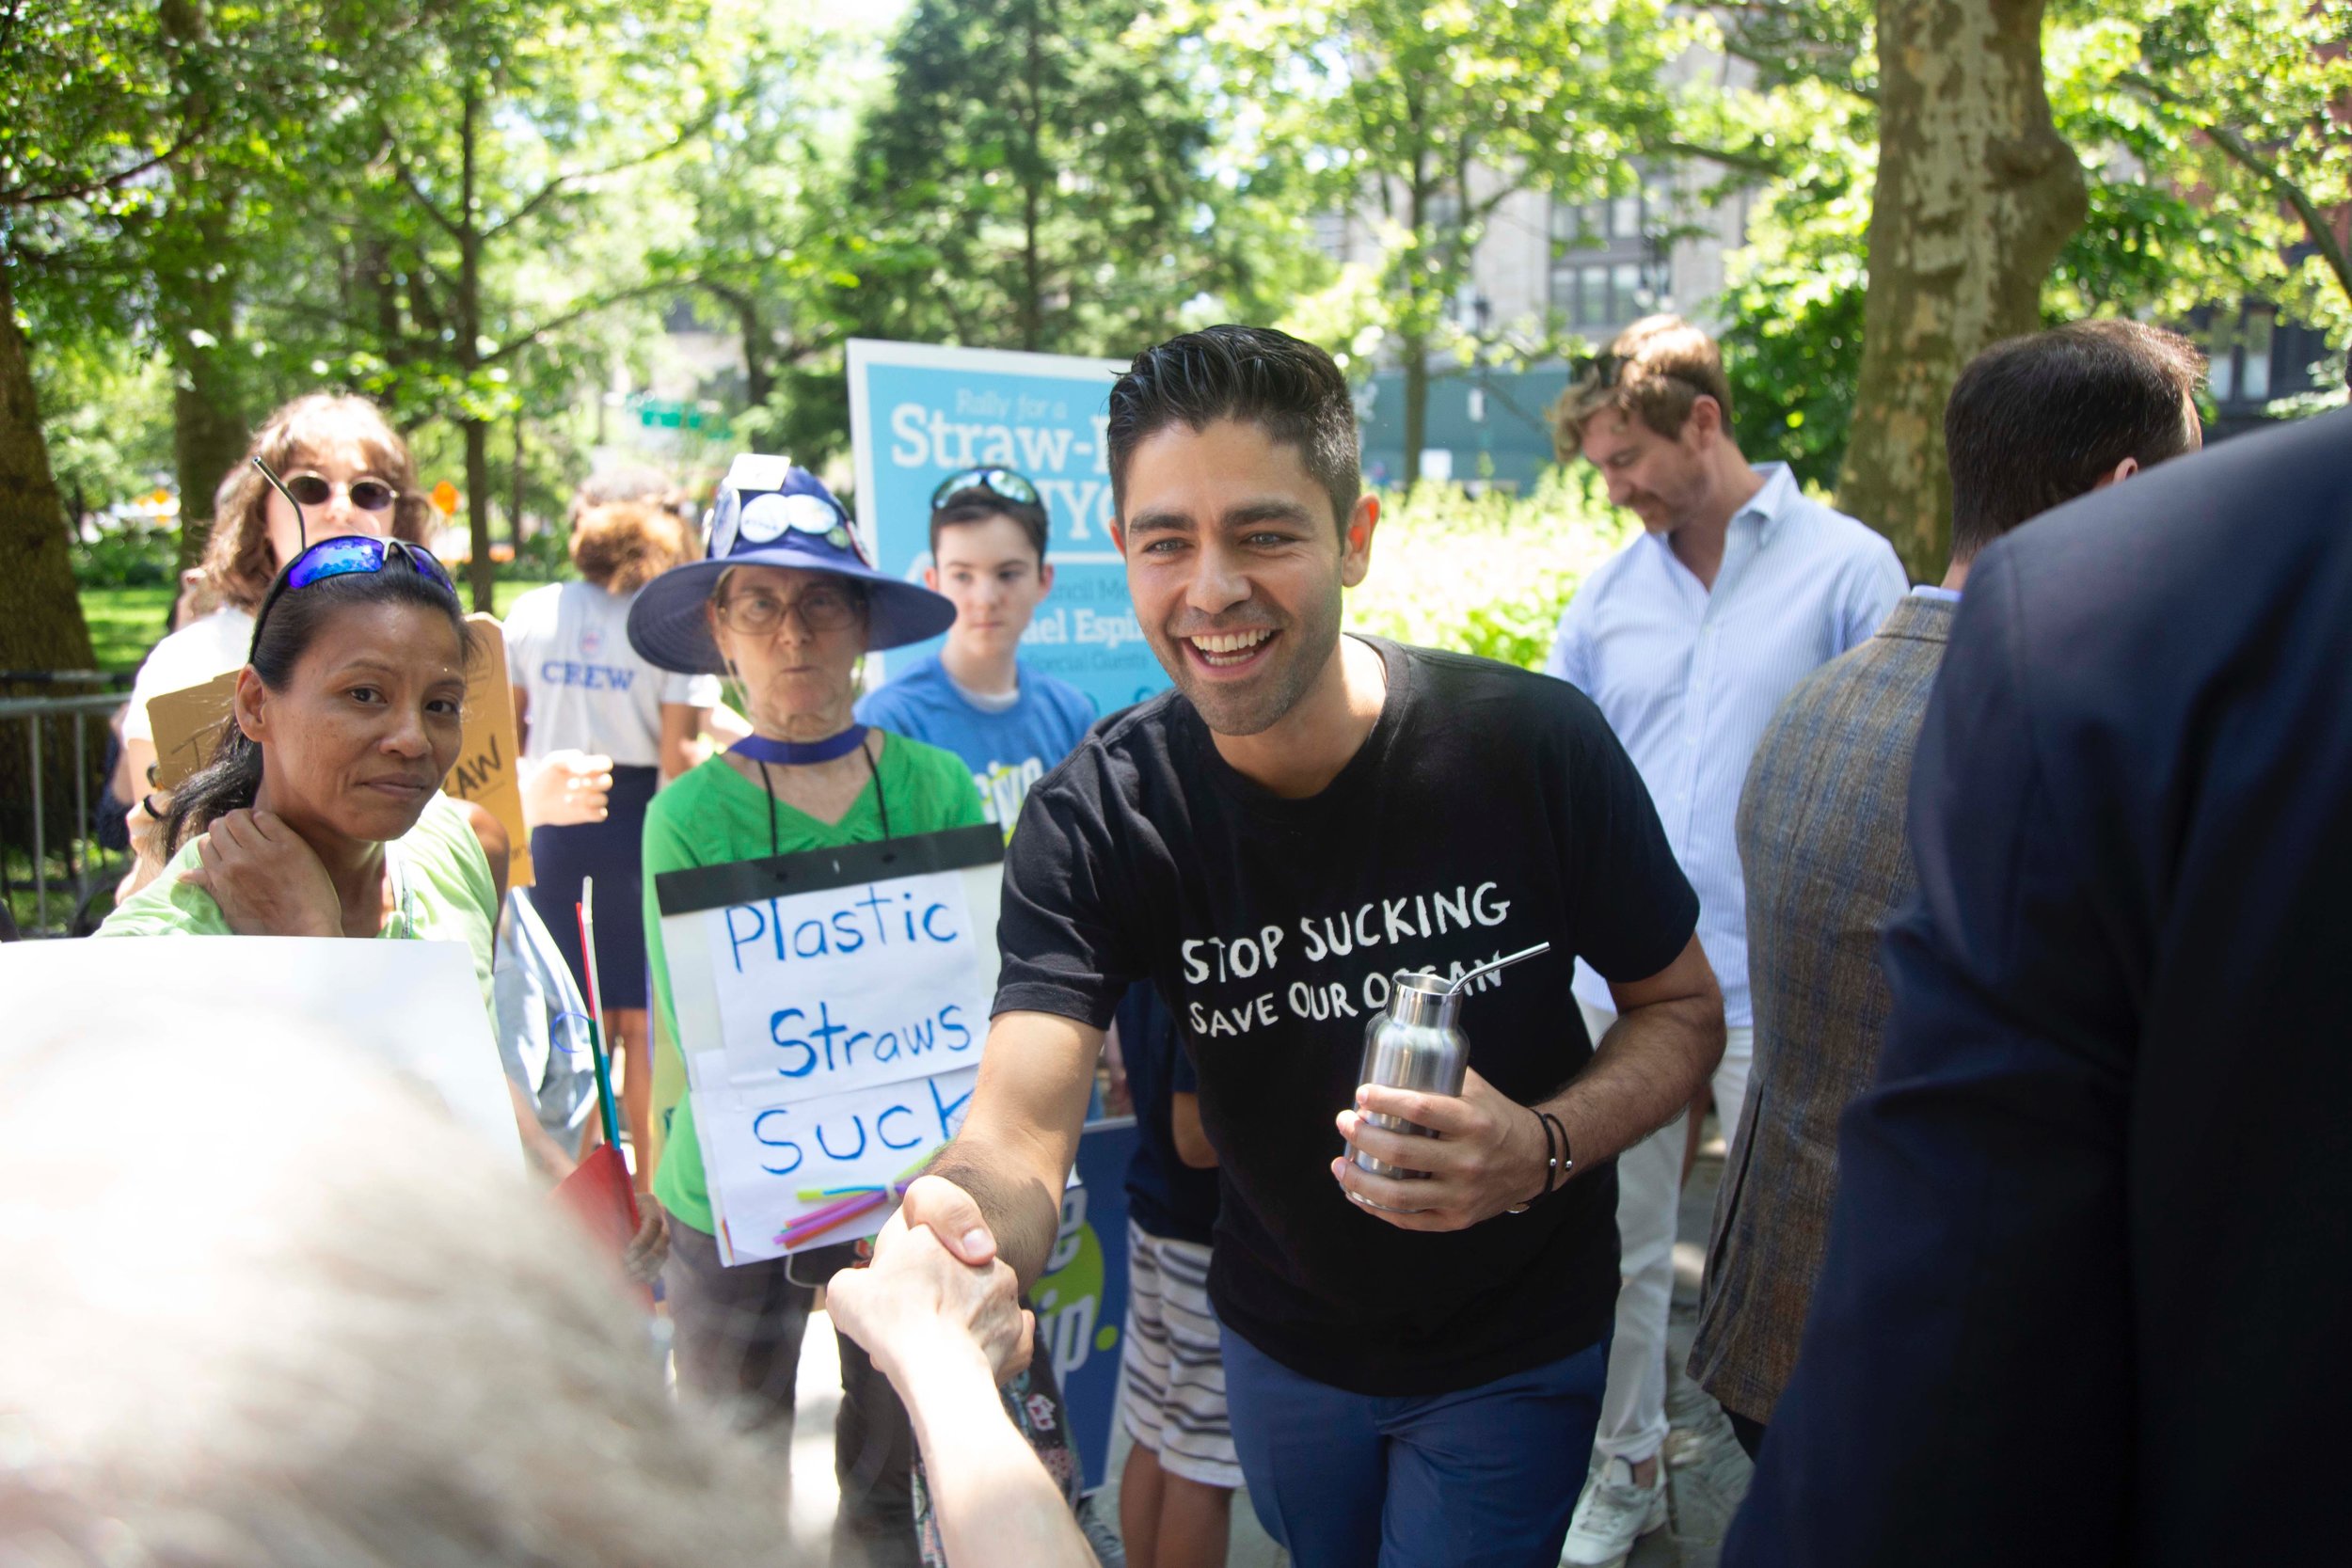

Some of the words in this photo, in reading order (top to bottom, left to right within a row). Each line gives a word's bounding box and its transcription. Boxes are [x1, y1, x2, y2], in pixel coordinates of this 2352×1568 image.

[541, 661, 636, 691] CREW
[445, 733, 503, 800] AW
[724, 885, 959, 974] Plastic
[1181, 925, 1284, 985] STOP
[1299, 880, 1511, 963] SUCKING
[1188, 991, 1279, 1037] SAVE
[1287, 980, 1359, 1022] OUR
[1362, 950, 1503, 1010] OAN
[770, 1001, 972, 1079] Straws
